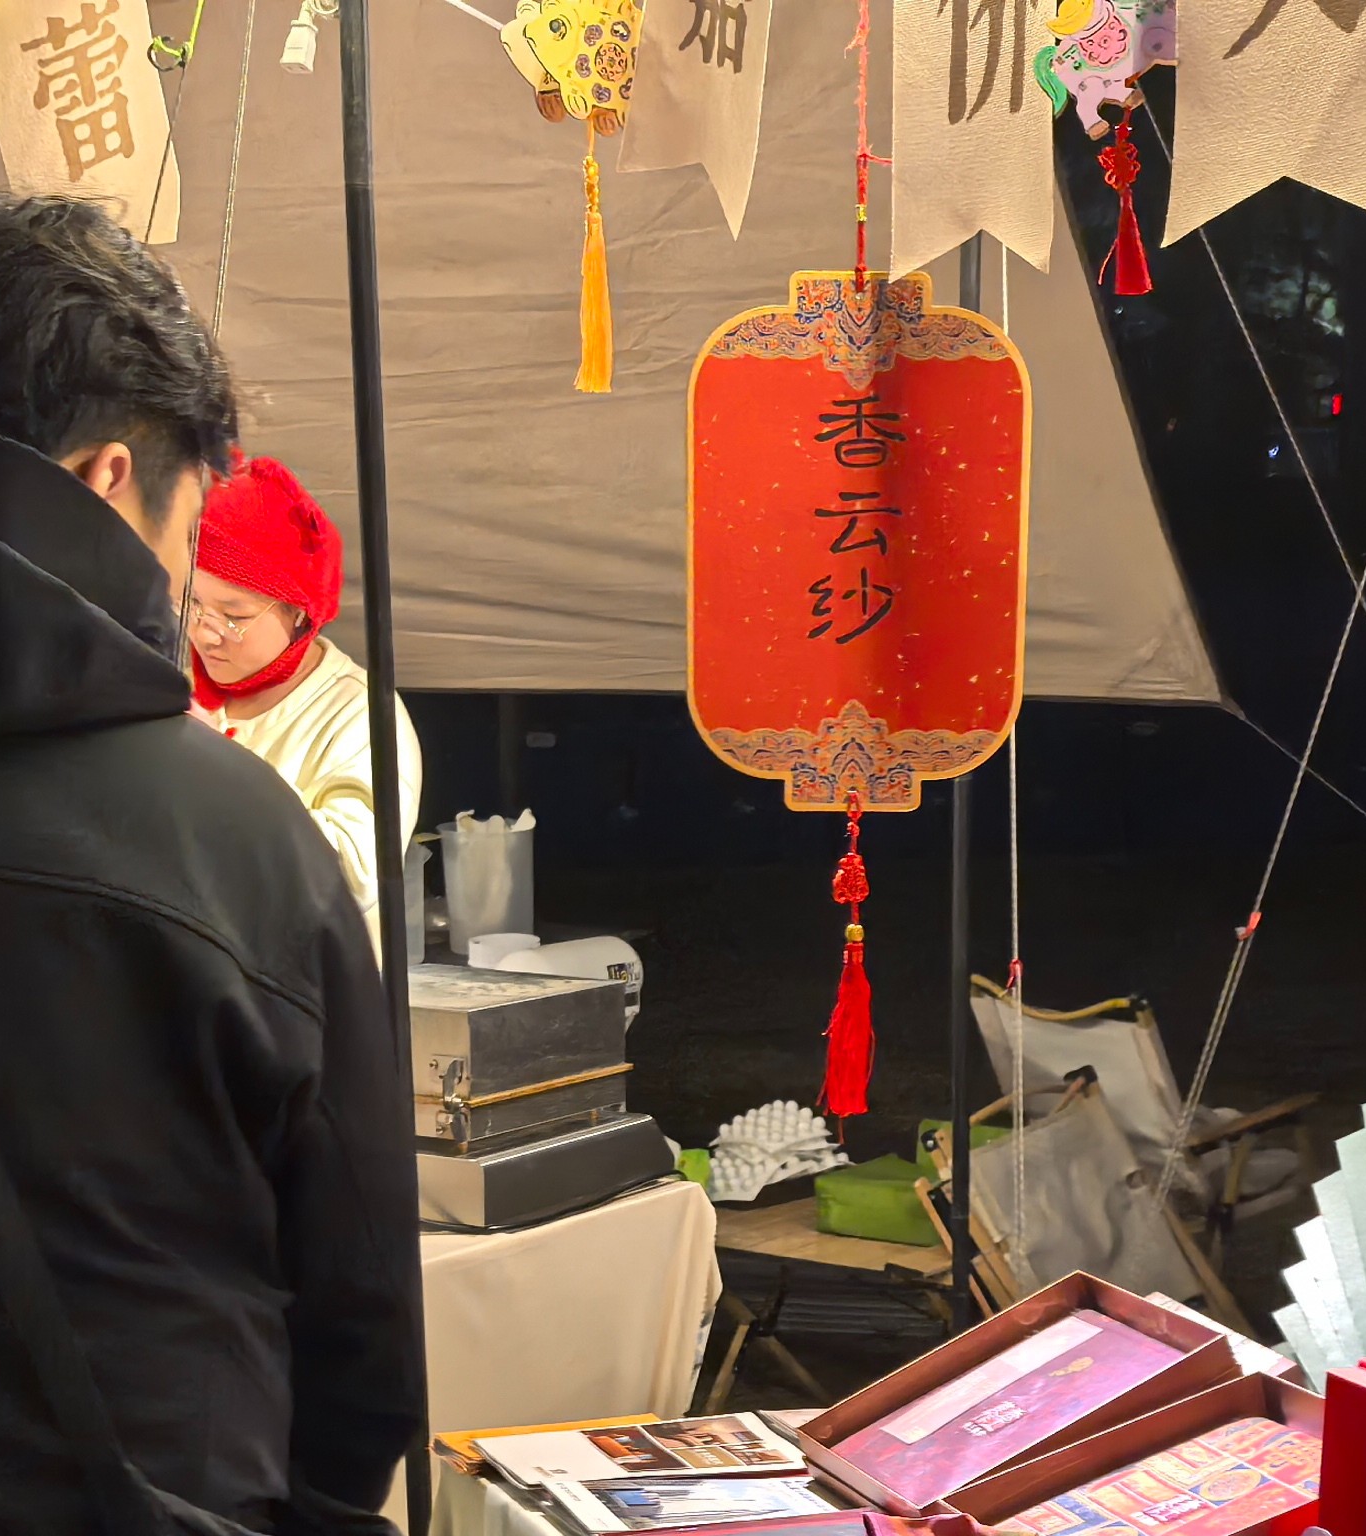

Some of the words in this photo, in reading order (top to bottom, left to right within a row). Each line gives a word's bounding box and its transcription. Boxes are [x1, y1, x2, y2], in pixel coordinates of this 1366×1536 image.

[21, 0, 135, 182] 蕾
[807, 395, 907, 645] 香云纱
